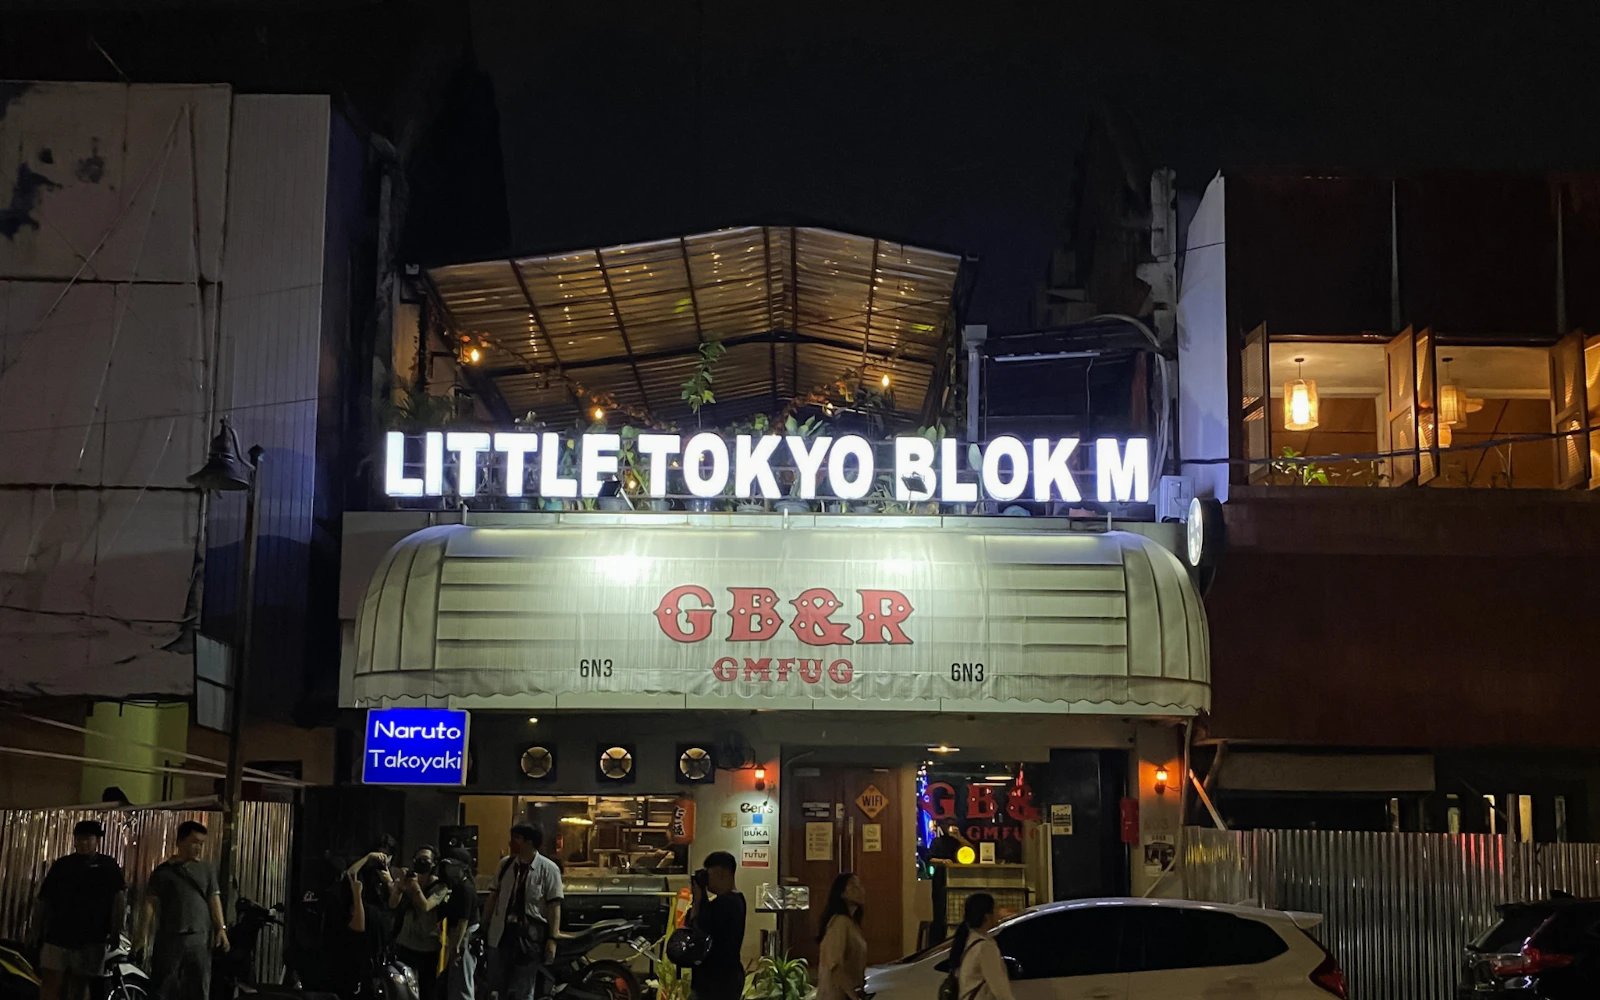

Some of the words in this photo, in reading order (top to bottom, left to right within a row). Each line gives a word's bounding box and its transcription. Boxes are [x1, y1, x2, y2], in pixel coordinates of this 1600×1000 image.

[385, 431, 621, 498] LITTLE
[638, 432, 874, 500] TOKYO
[895, 434, 1082, 503] BLOK
[1096, 437, 1150, 503] M
[652, 584, 915, 646] GB&R
[579, 658, 613, 679] 6N3
[711, 656, 854, 685] GMFUG
[951, 662, 985, 683] 6N3
[373, 720, 462, 740] Naruto
[368, 749, 462, 774] Takoyaki
[862, 795, 883, 807] WIFI
[966, 825, 1035, 841] GMFU
